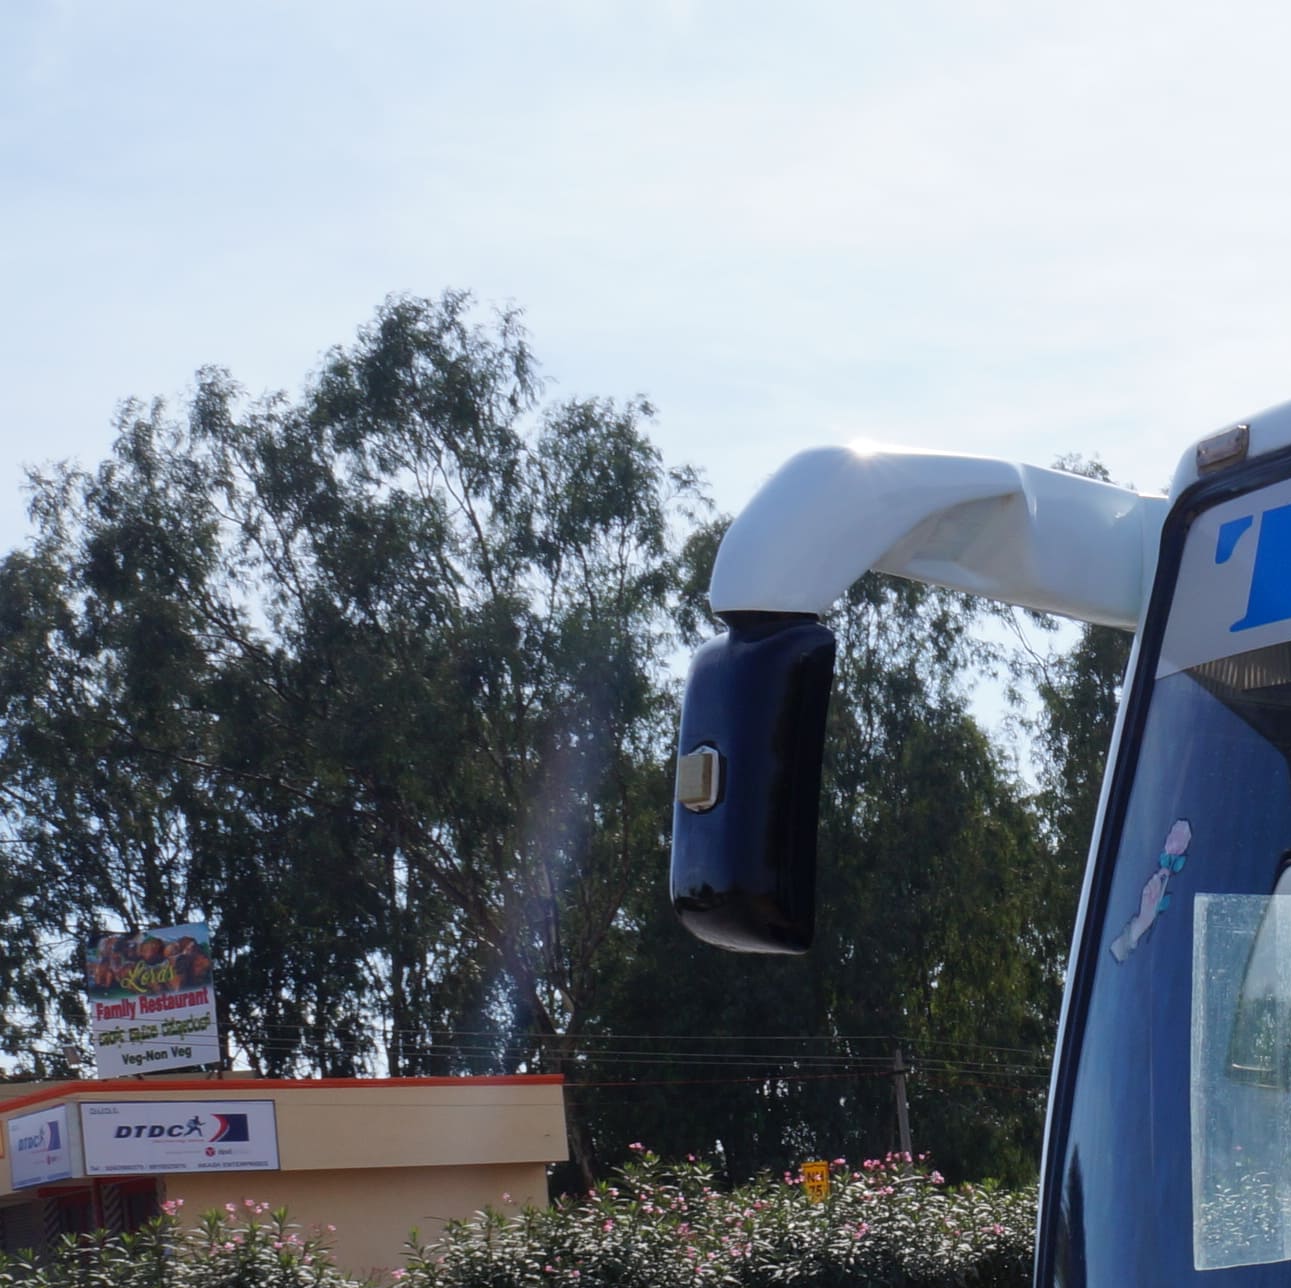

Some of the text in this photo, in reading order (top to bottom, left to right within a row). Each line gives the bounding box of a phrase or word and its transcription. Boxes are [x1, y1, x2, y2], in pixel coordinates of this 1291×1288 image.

[96, 987, 209, 1021] Family Restaurant
[121, 1046, 192, 1066] Veg-Non Veg
[114, 1124, 184, 1139] DTDC
